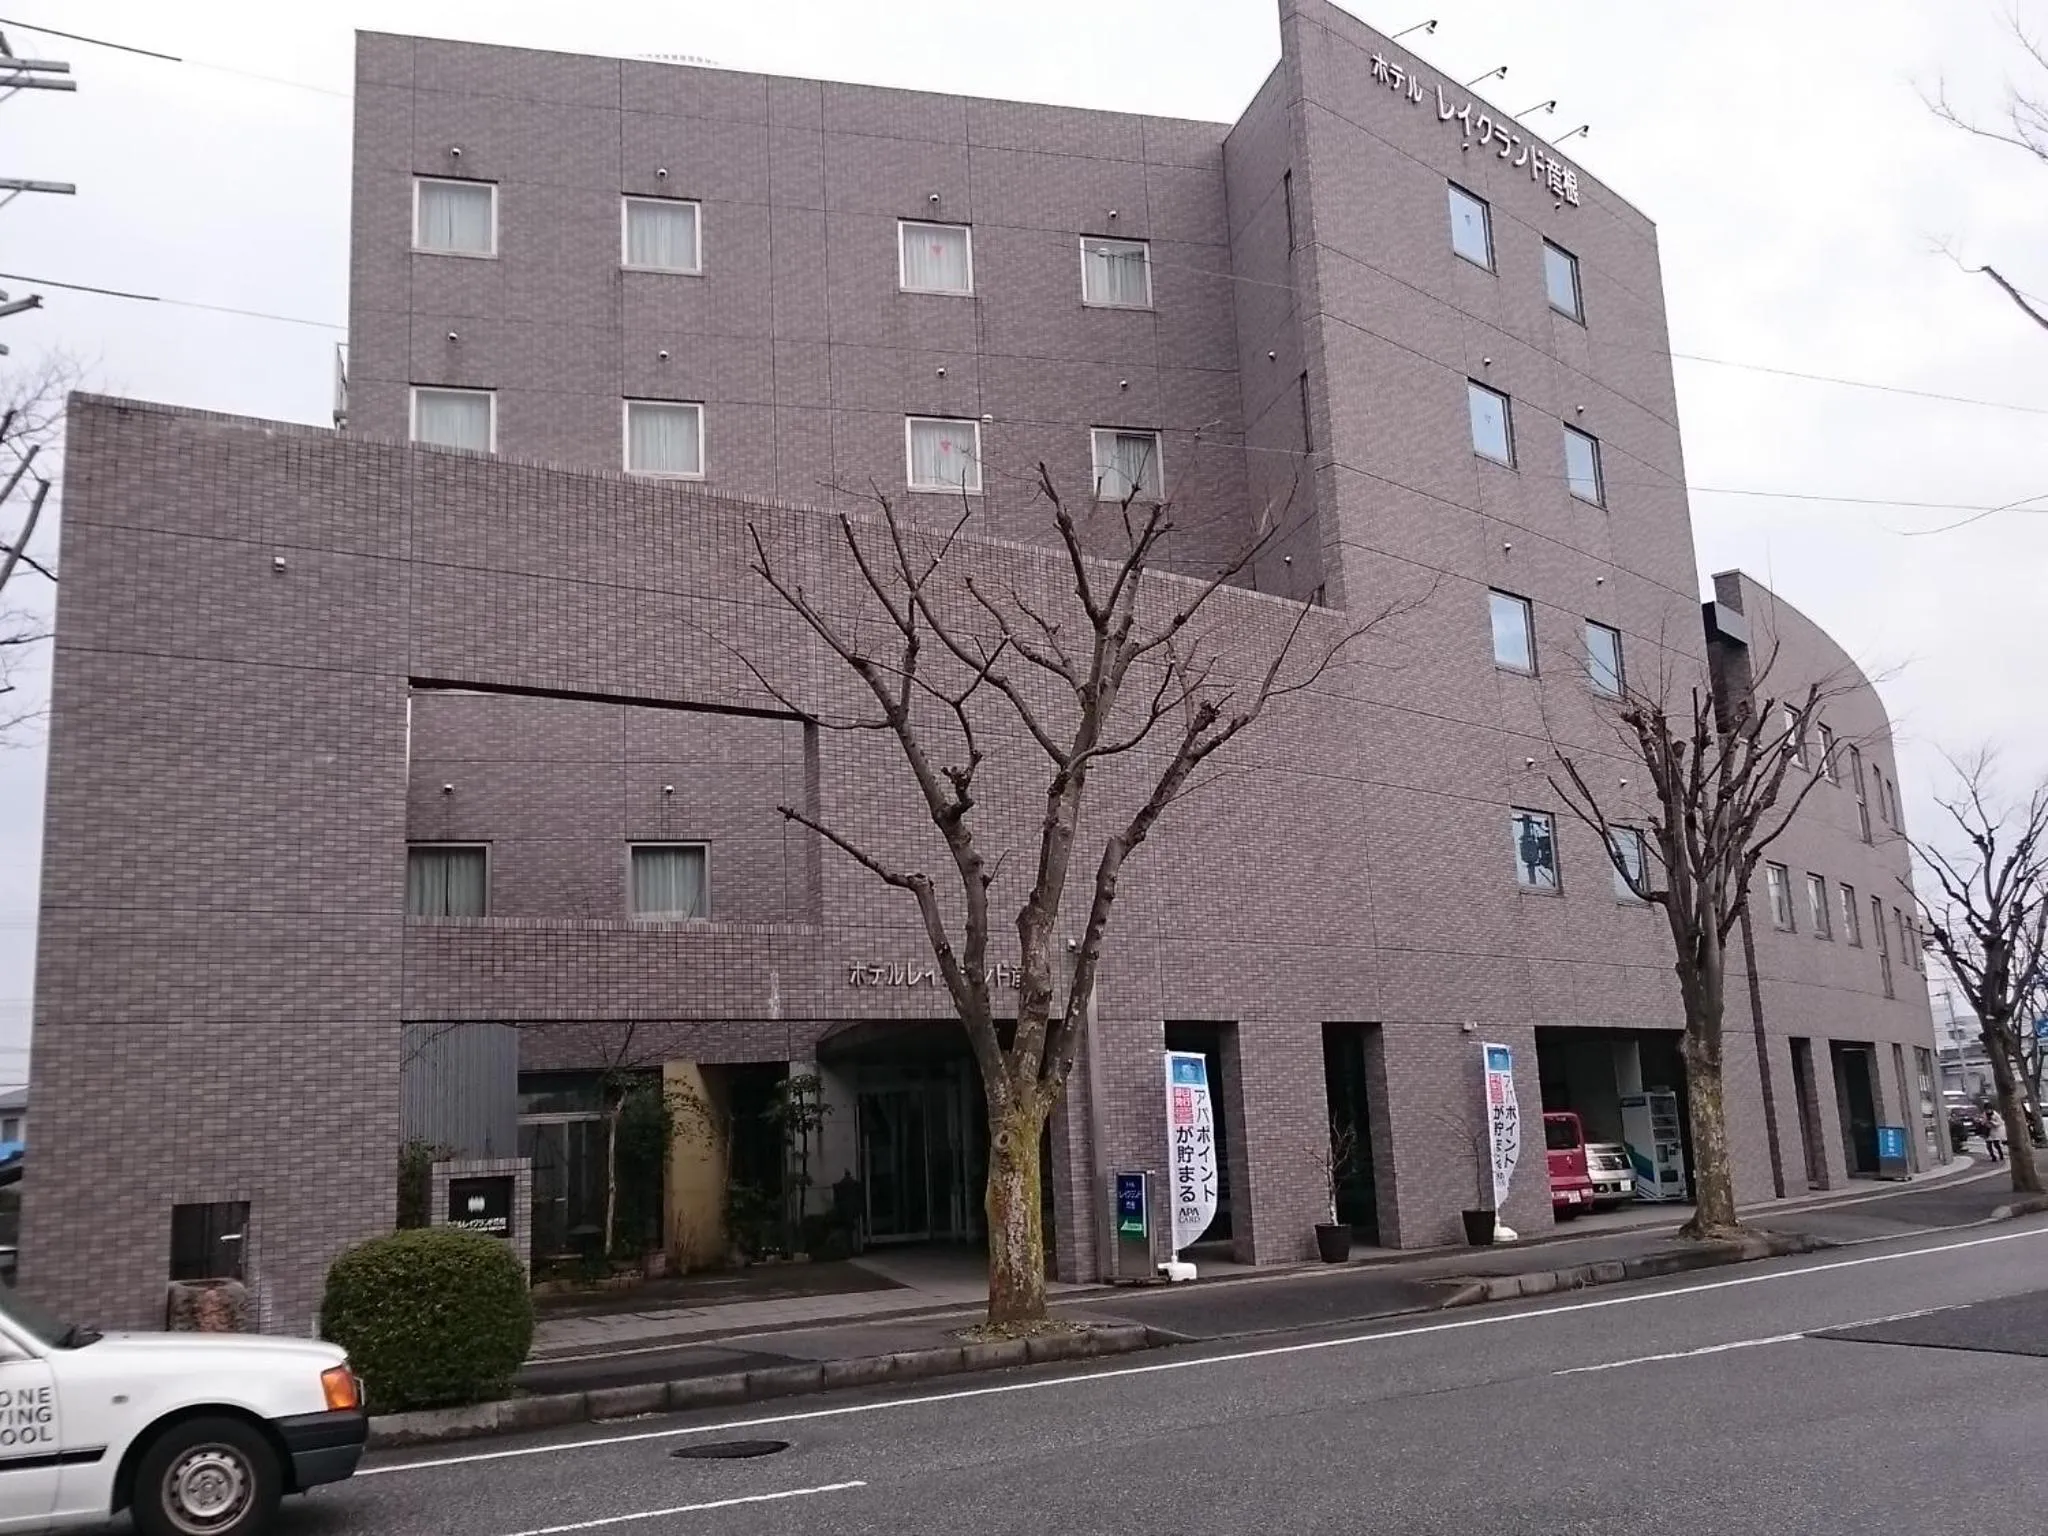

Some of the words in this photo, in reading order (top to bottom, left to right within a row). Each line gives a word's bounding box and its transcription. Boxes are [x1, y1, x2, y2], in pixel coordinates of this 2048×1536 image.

[1370, 52, 1422, 102] ホテル
[1194, 1089, 1215, 1203] アパポイント
[1176, 1126, 1197, 1203] が貯まる
[1179, 1207, 1200, 1216] APA
[0, 1406, 51, 1425] ING
[0, 1426, 53, 1446] OOL
